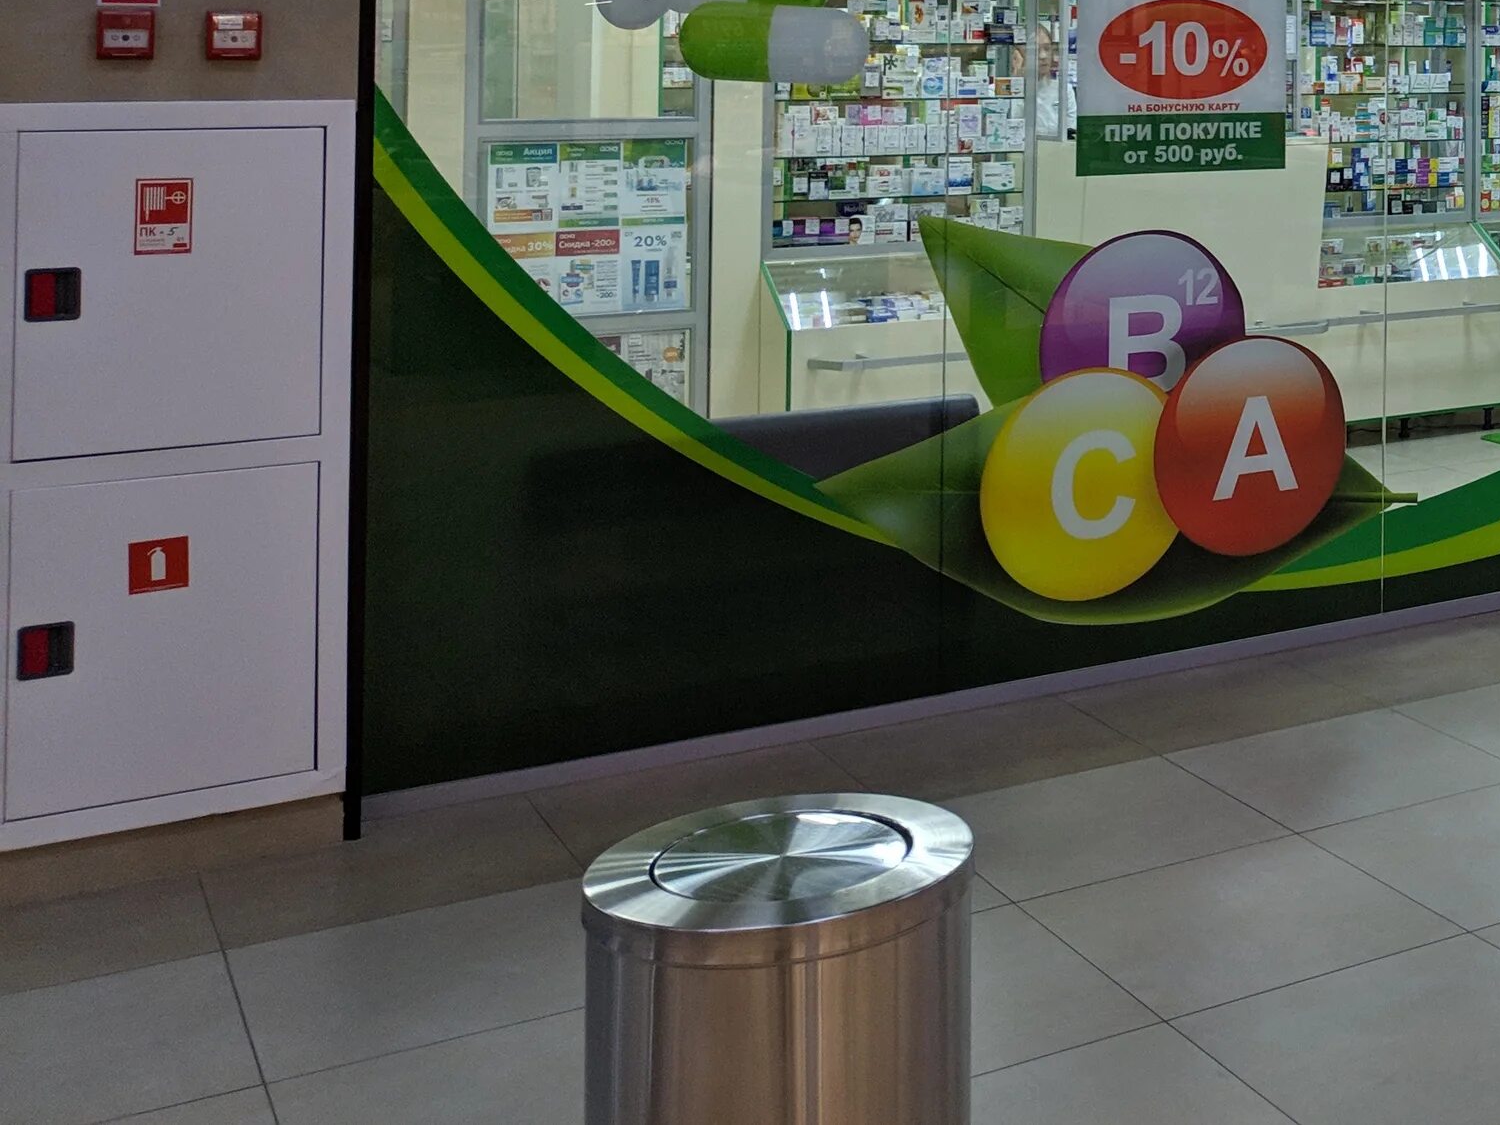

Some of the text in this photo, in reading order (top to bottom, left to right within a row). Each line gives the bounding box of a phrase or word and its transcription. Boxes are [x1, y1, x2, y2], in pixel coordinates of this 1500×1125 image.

[1119, 20, 1250, 77] -10%
[1128, 102, 1240, 113] НА БОНУСНУЮ КАРТУ
[1105, 121, 1262, 143] ПРИ ПОКУПКЕ
[1123, 145, 1244, 166] от 500 руб.
[633, 235, 667, 248] 20%
